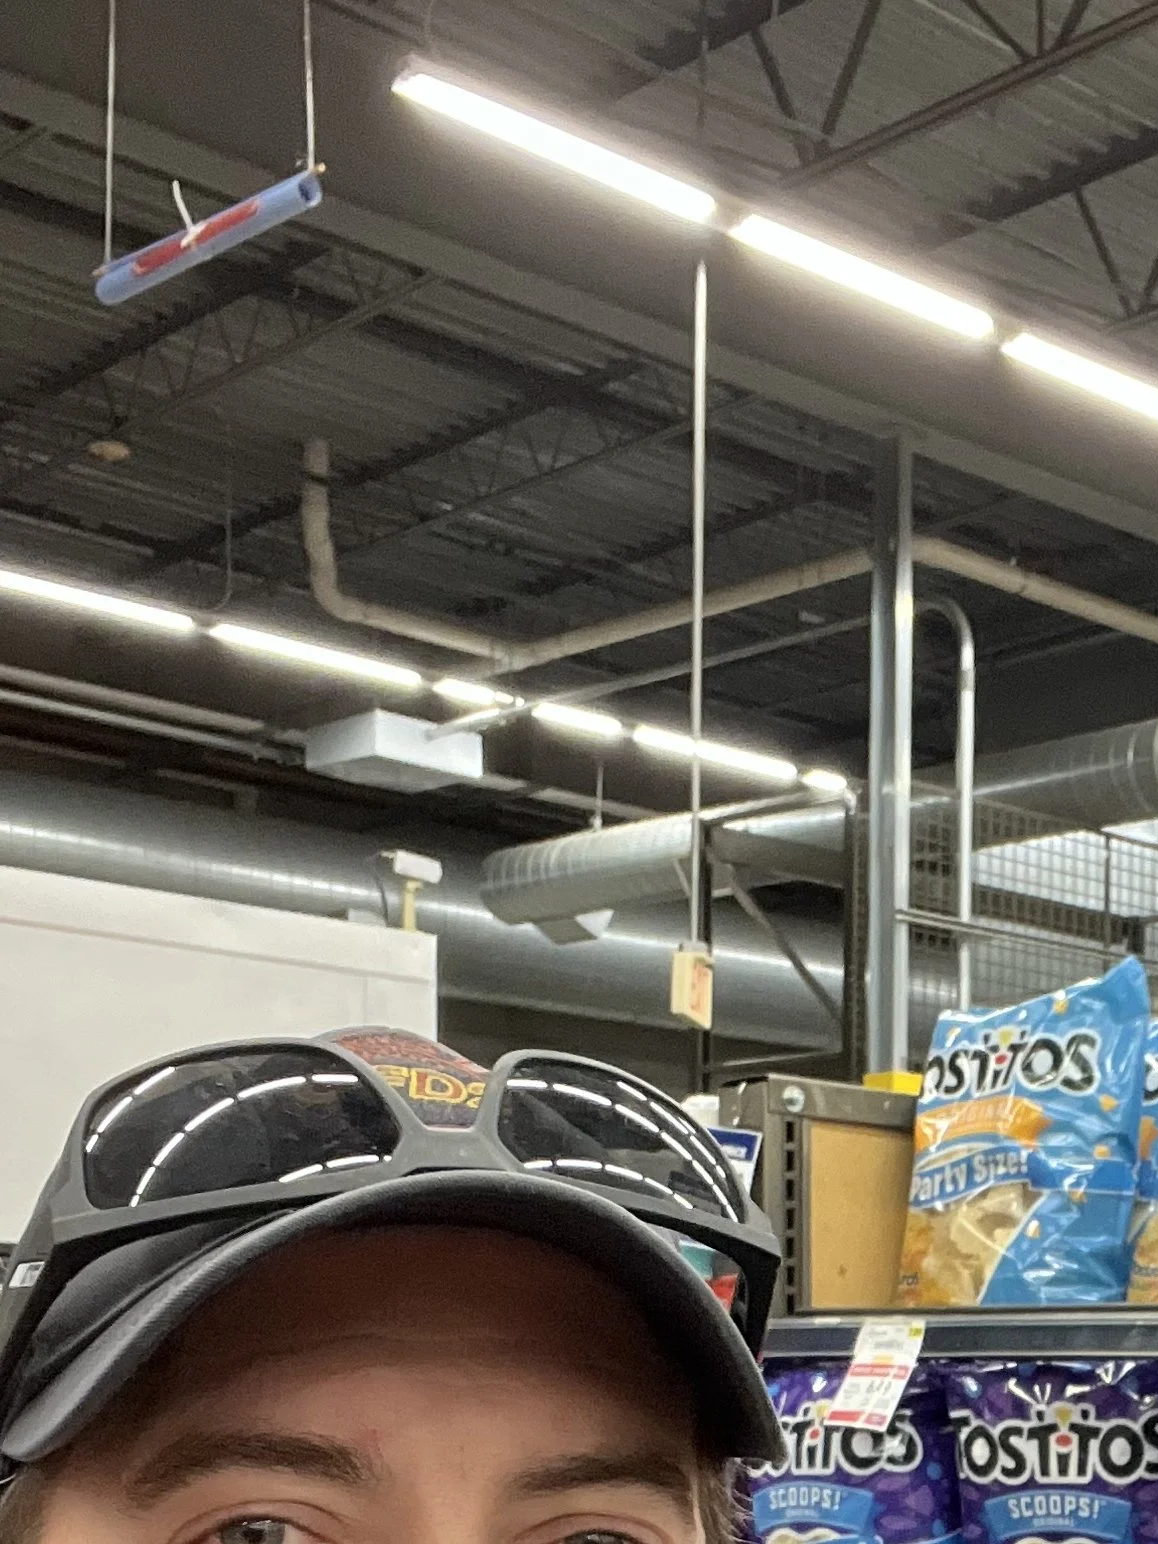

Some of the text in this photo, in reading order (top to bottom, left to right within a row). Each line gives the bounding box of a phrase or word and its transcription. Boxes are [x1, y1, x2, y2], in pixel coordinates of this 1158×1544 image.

[911, 1150, 1029, 1202] Party Size!
[770, 1486, 841, 1511] SCOOPS!
[1007, 1494, 1100, 1520] SCOOPS!
